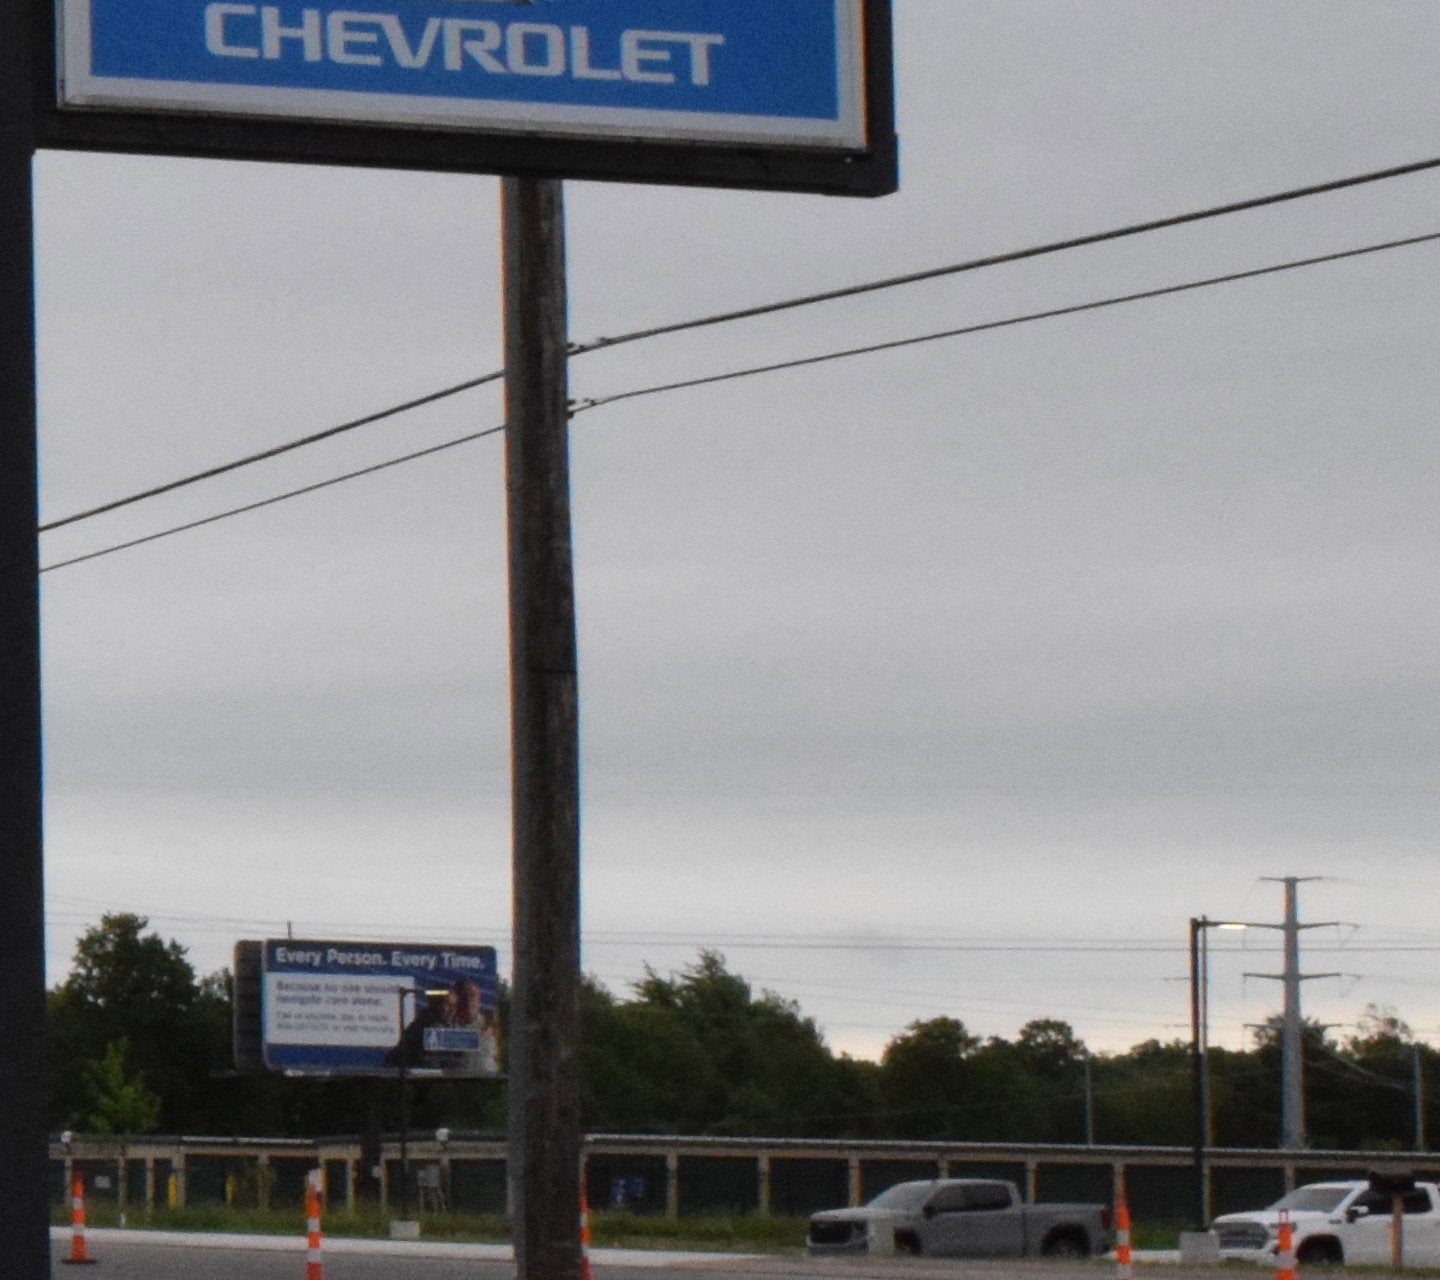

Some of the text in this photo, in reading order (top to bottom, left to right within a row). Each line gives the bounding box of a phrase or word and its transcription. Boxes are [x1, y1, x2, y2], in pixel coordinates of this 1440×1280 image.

[204, 2, 724, 86] CHEVROLET
[276, 947, 485, 970] Every Person. Every Time.
